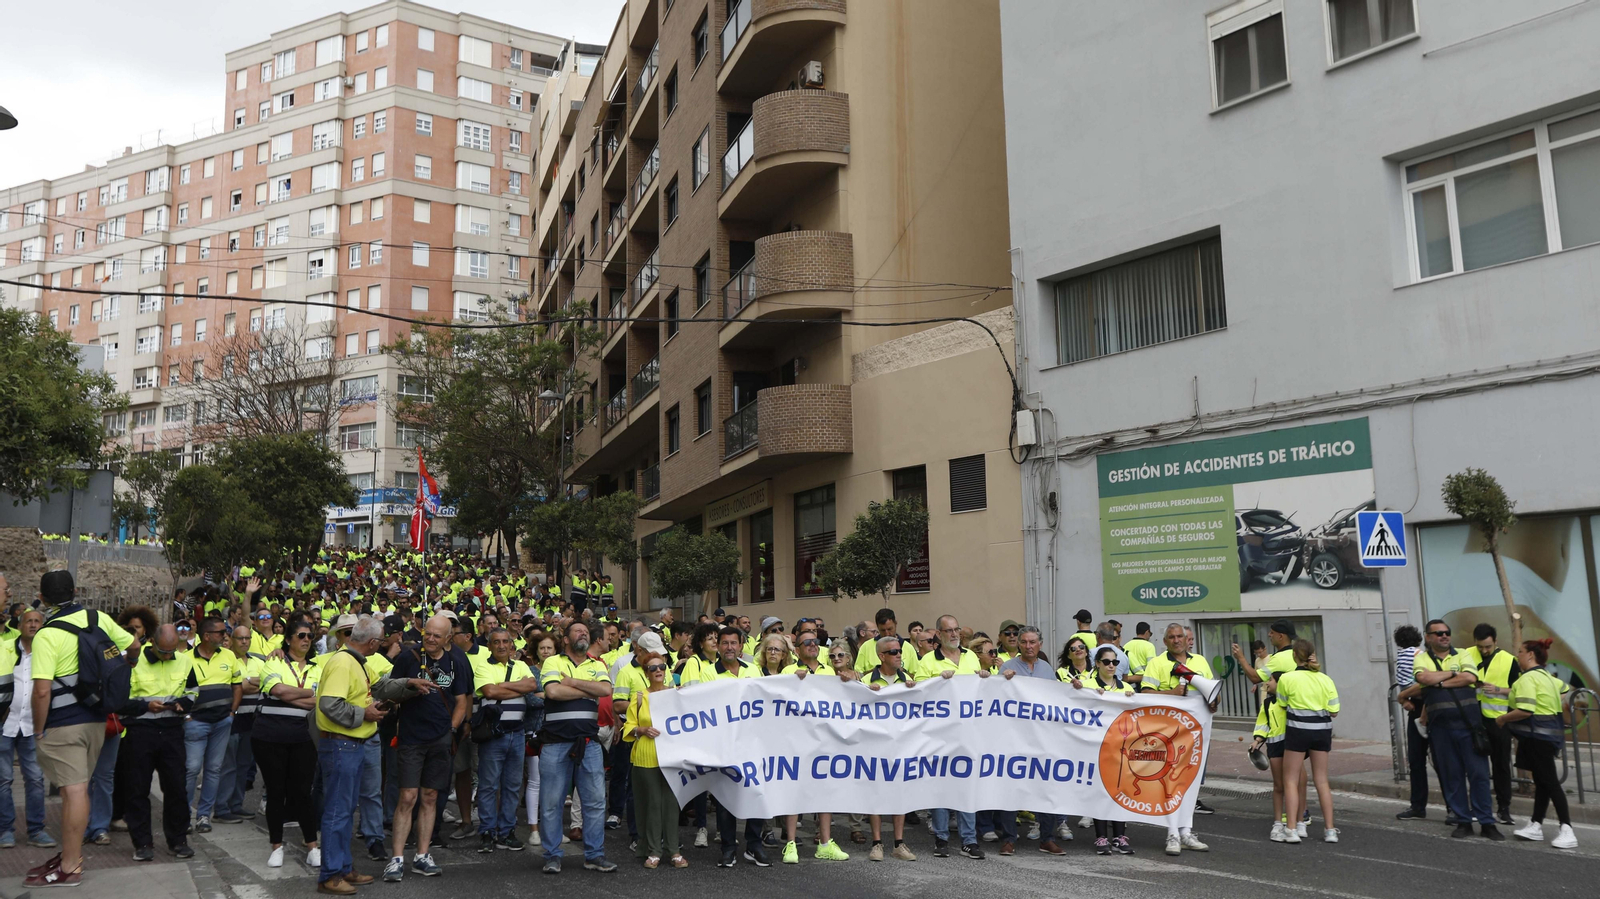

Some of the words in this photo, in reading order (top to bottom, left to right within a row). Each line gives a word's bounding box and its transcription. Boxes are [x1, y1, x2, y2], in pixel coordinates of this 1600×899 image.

[1108, 462, 1160, 483] GESTIÓN
[1164, 462, 1180, 477] DE
[1183, 451, 1264, 474] ACCIDENTES
[1268, 449, 1286, 464] DE
[1290, 440, 1355, 461] TRÁFICO
[1108, 502, 1138, 513] ATENCIÓN
[1140, 501, 1169, 510] INTEGRAL
[1170, 495, 1224, 507] PERSONALIZADA
[1110, 525, 1158, 537] CONCERTADO
[1160, 524, 1178, 533] CON
[1180, 522, 1206, 531] TODAS
[1208, 520, 1223, 529] LAS
[1120, 534, 1165, 546] COMPAÑÍAS
[1167, 535, 1176, 543] DE
[1178, 532, 1215, 542] SEGUROS
[1122, 560, 1144, 568] MEJORES
[1145, 558, 1185, 567] PROFESIONALES
[1193, 563, 1222, 571] GIBRALTAR
[1140, 588, 1158, 599] SIN
[1160, 586, 1201, 598] COSTES
[665, 708, 718, 736] CON
[725, 699, 764, 724] LOS
[772, 699, 950, 720] TRABAJADORES
[959, 699, 984, 719] DE
[987, 699, 1104, 727] ACERINOX
[1129, 709, 1145, 722] ¡NI
[1149, 708, 1166, 716] UN
[1167, 710, 1195, 729] PASO
[762, 756, 800, 783] UN
[811, 755, 973, 782] CONVENIO
[979, 753, 1095, 786] DIGNO!!
[1115, 791, 1152, 813] ¡TODOS
[1154, 803, 1163, 813] A
[1164, 790, 1183, 812] UNA!
